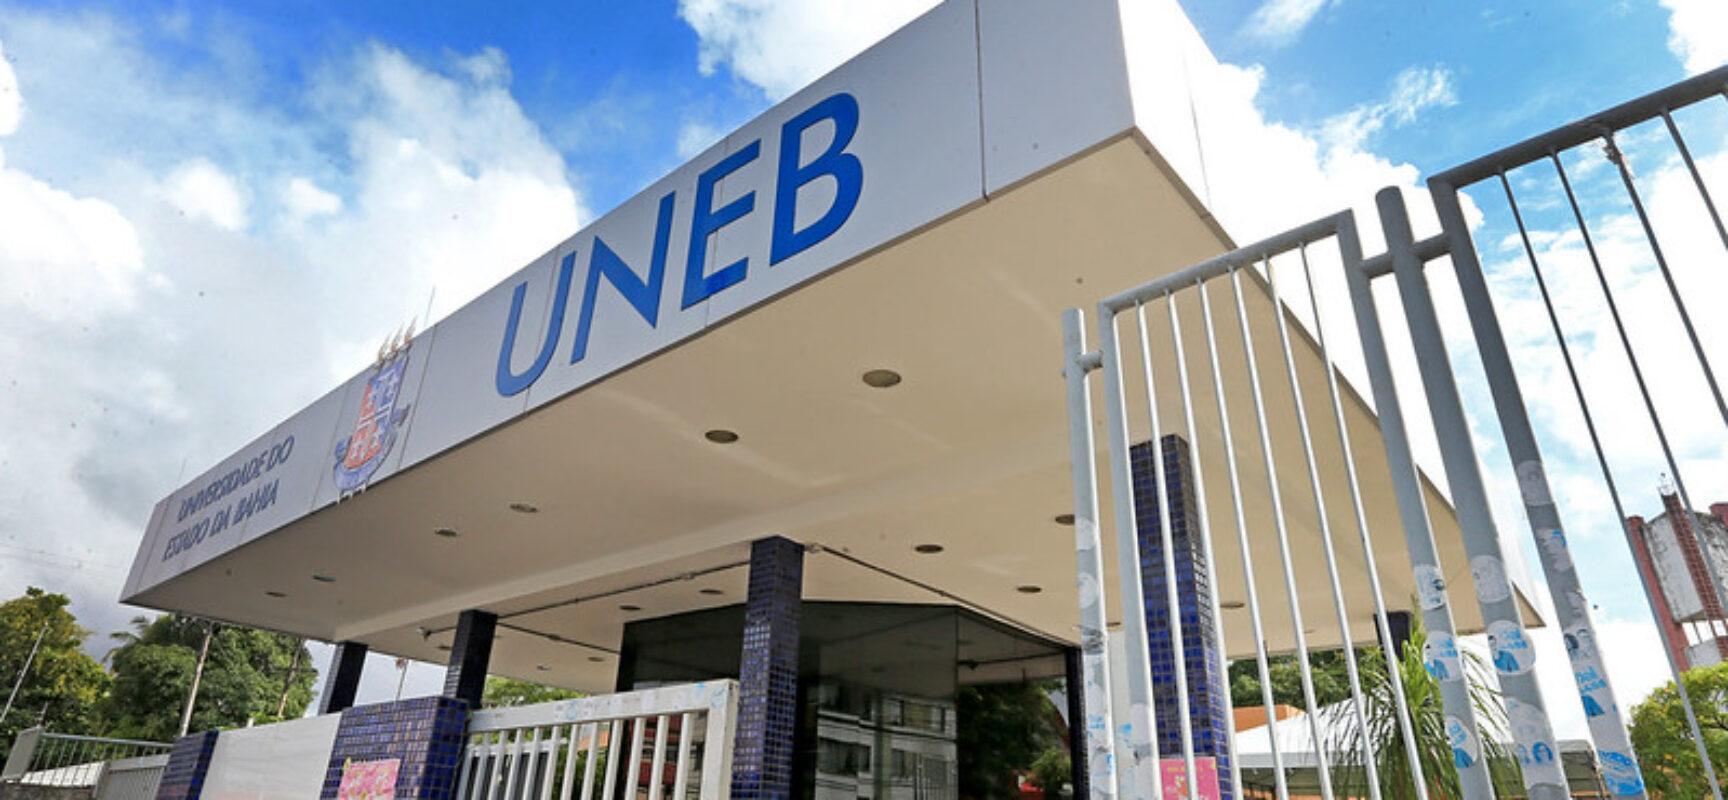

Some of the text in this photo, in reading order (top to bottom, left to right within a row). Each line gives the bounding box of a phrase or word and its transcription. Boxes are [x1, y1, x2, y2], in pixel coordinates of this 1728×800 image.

[495, 92, 863, 397] UNEB
[162, 478, 279, 562] ESTADO DA BAHIA
[177, 435, 295, 523] UNIVERSIDADE DO
